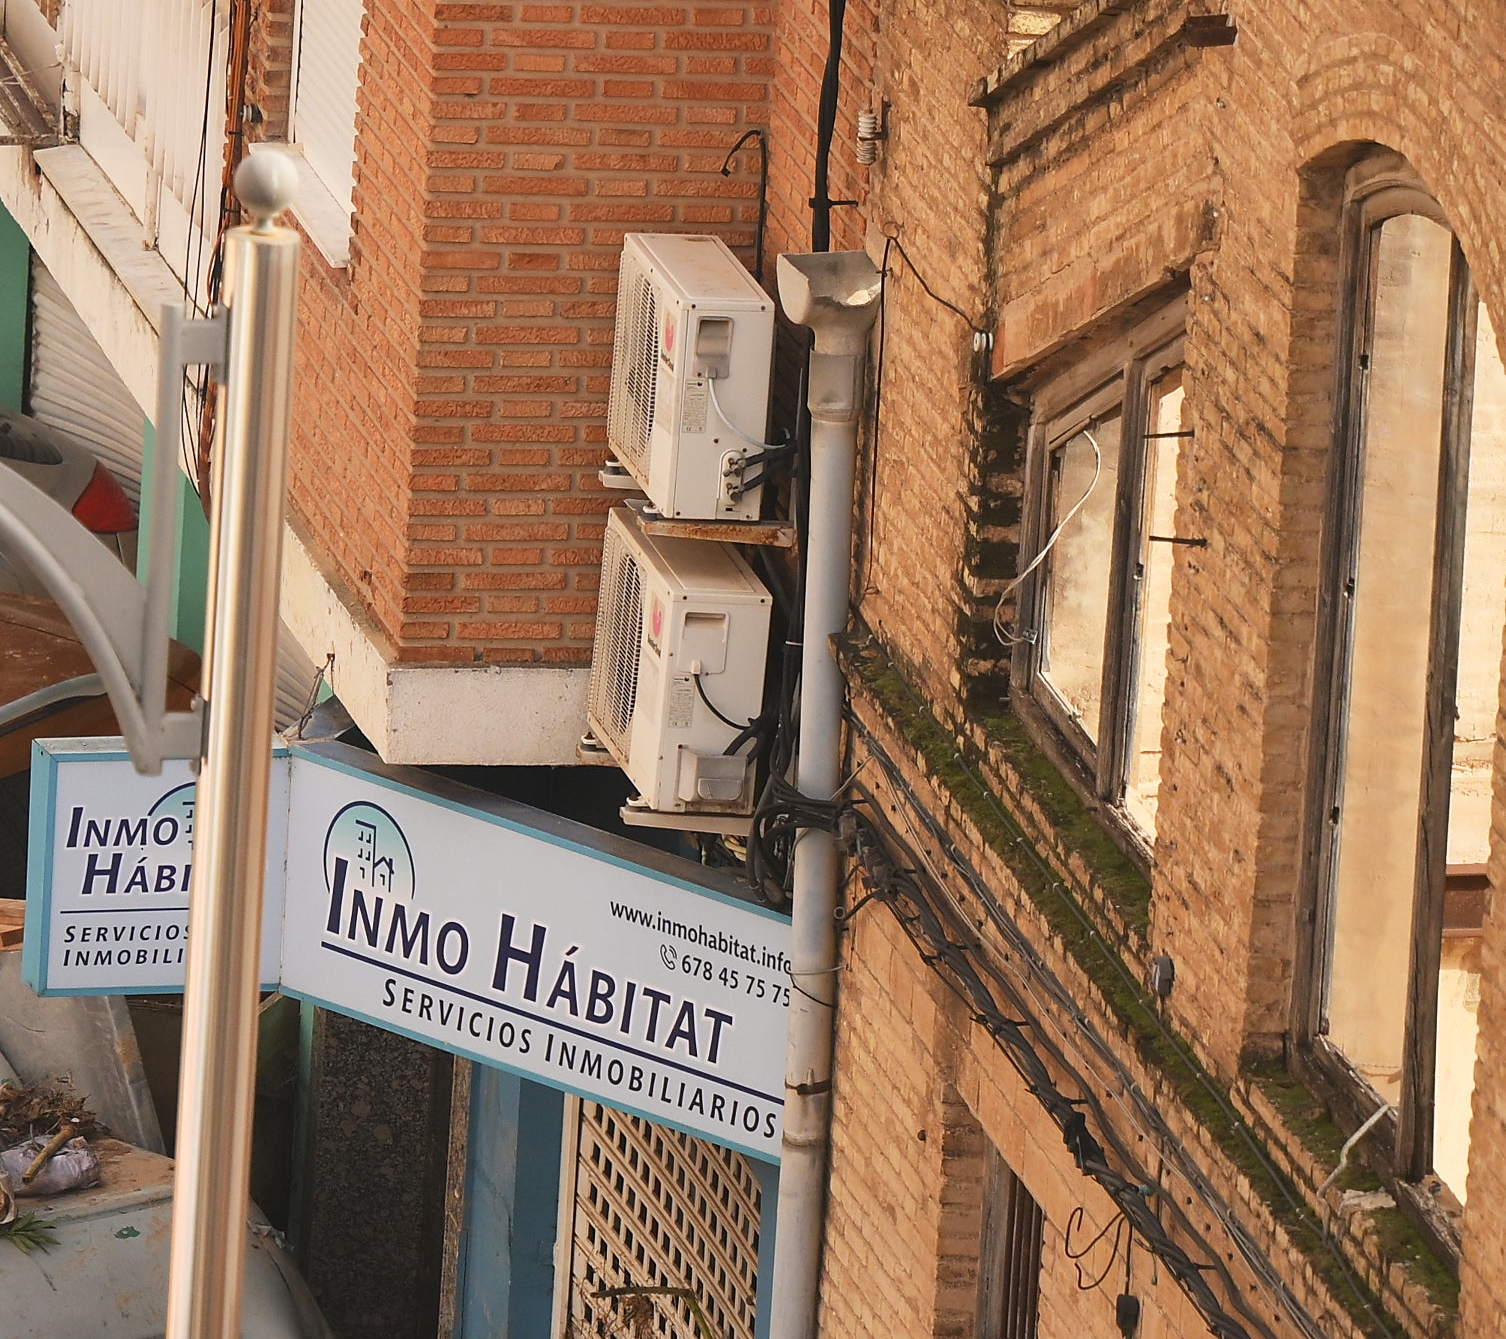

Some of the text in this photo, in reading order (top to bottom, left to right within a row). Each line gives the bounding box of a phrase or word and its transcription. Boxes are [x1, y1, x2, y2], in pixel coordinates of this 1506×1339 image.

[609, 900, 792, 975] www.inmohabitat.info
[681, 954, 791, 1008] 678 45 75 75
